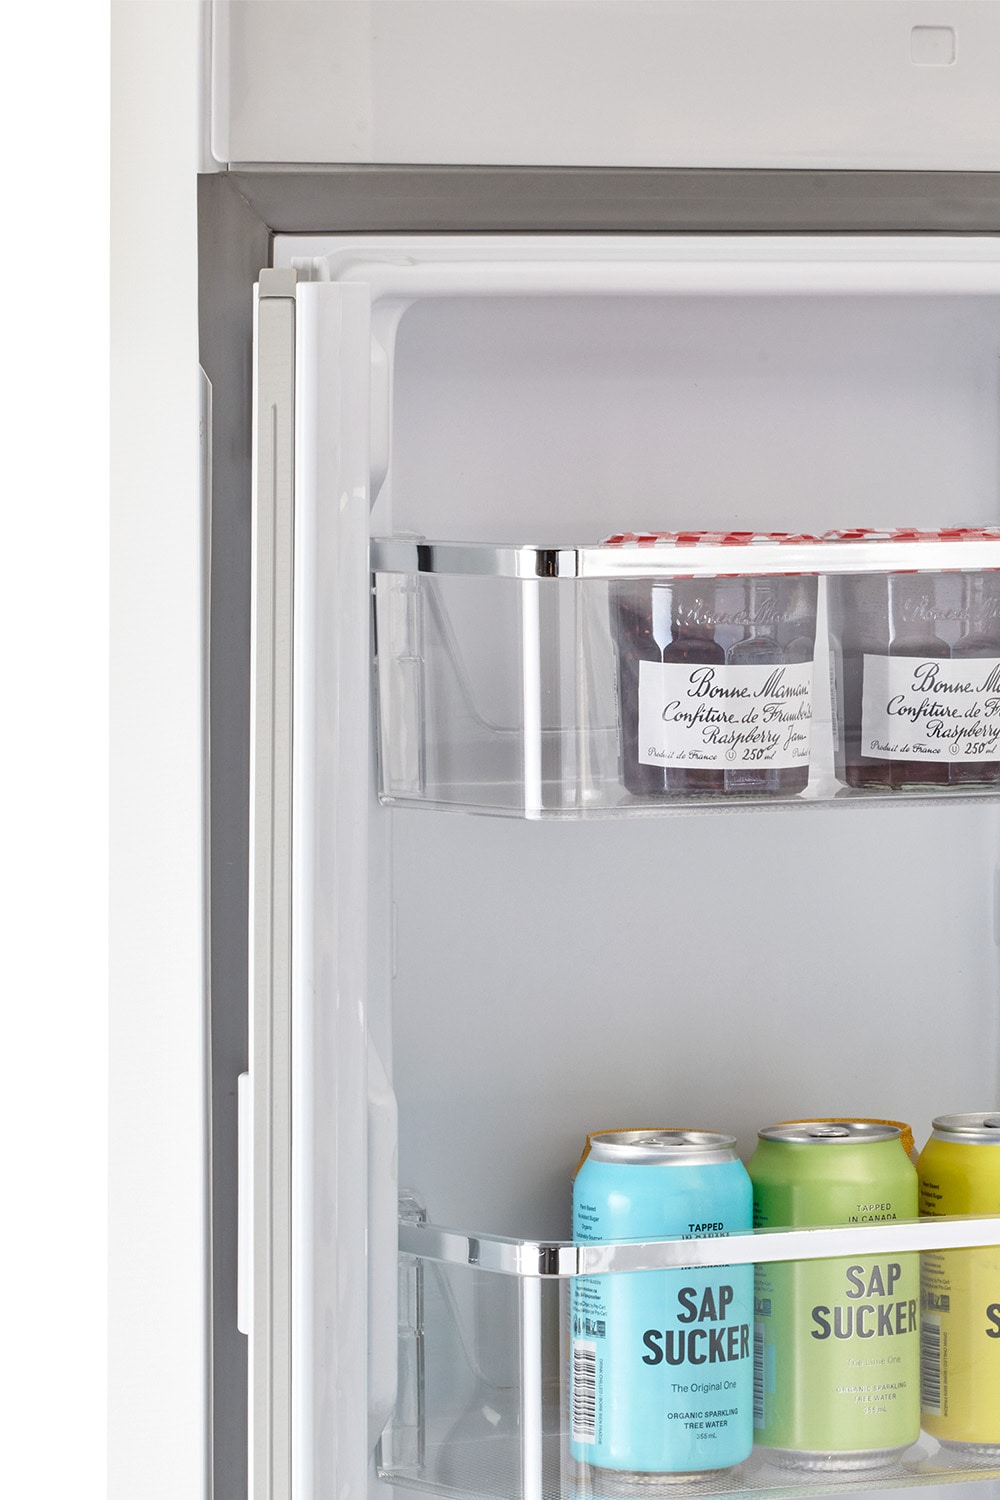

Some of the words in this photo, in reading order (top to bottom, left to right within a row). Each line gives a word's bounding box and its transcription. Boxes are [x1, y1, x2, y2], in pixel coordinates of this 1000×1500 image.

[686, 667, 751, 698] Bonne
[753, 667, 809, 698] Maman
[911, 662, 974, 693] Bonne
[662, 700, 739, 729] Confiture
[741, 707, 758, 724] de
[886, 695, 962, 722] Confiture
[964, 702, 981, 718] de
[702, 725, 781, 751] Raspberry
[688, 749, 717, 760] France
[741, 748, 762, 761] 250
[912, 743, 941, 754] France
[964, 742, 985, 755] 250
[857, 1203, 891, 1212] TAPPED
[861, 1213, 897, 1222] CANADA
[688, 1222, 724, 1232] TAPPED
[845, 1263, 901, 1299] SAP
[676, 1285, 734, 1323] SAP
[811, 1299, 917, 1340] SUCKER
[642, 1324, 750, 1366] SUCKER
[671, 1383, 689, 1393] The
[690, 1381, 723, 1394] Original
[724, 1381, 736, 1390] One
[874, 1381, 907, 1392] SPARKLING
[667, 1412, 703, 1420] ORGANIC
[704, 1408, 738, 1418] SPARKLING
[705, 1420, 728, 1429] WATER
